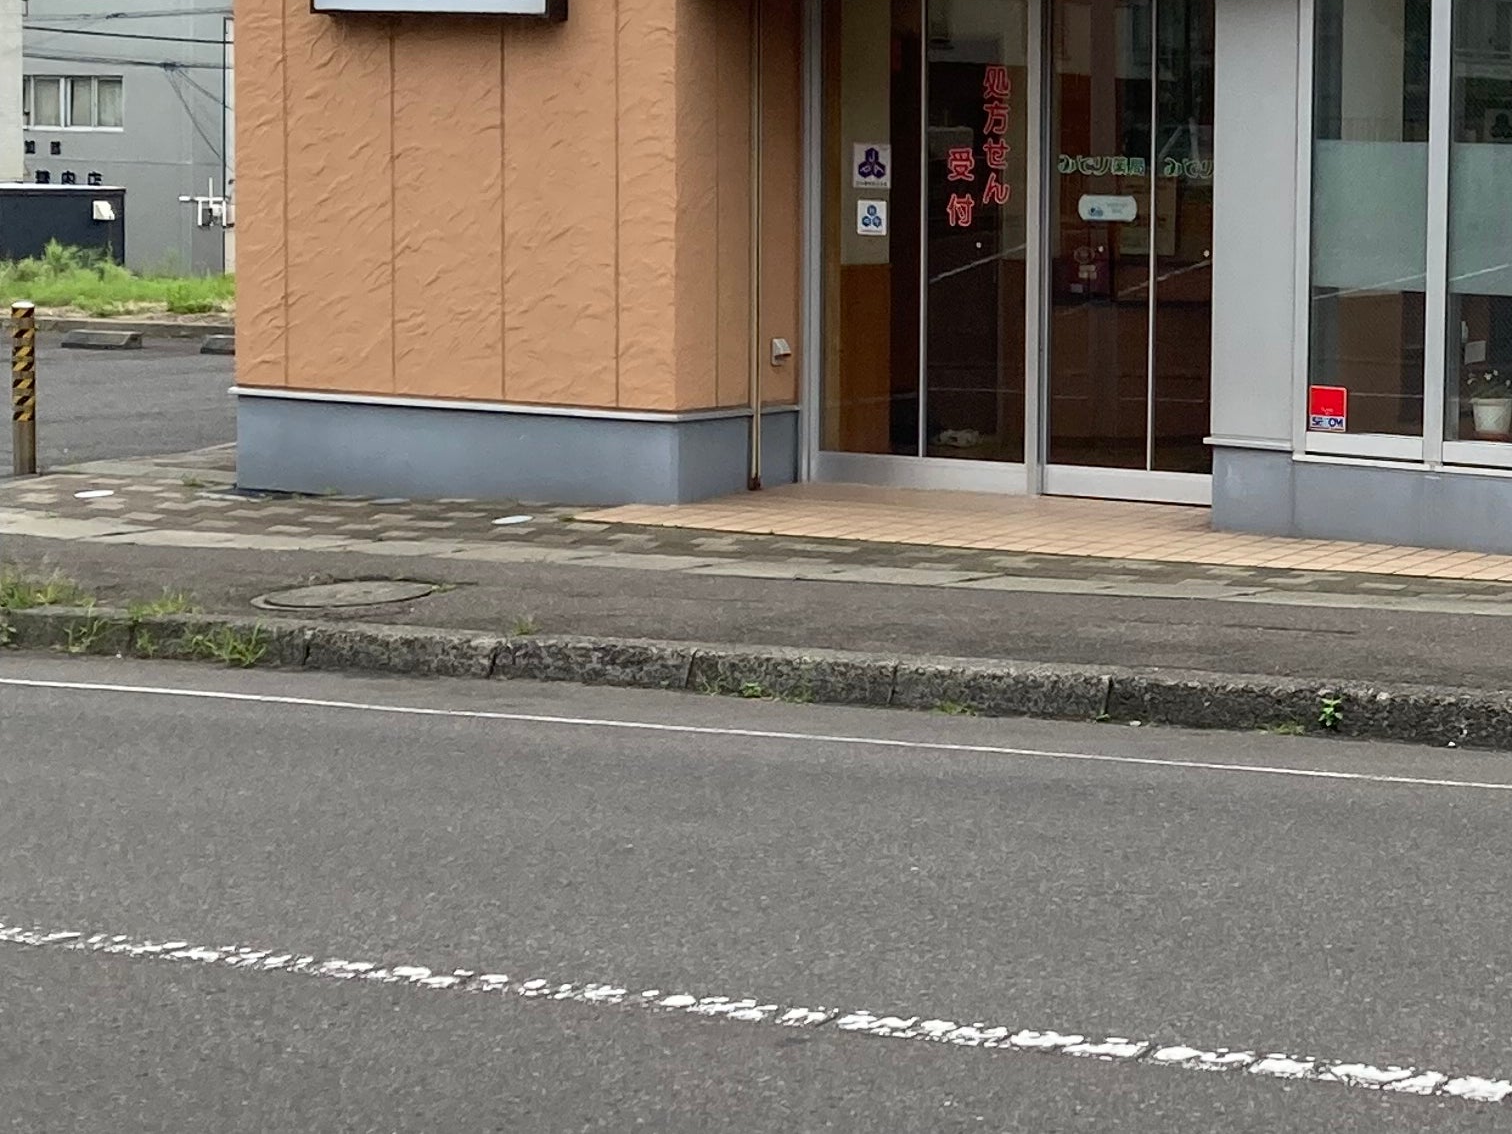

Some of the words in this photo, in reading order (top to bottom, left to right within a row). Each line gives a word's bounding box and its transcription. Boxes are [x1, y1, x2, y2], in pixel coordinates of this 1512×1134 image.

[947, 148, 975, 227] 受付
[983, 67, 1011, 204] 処方せん
